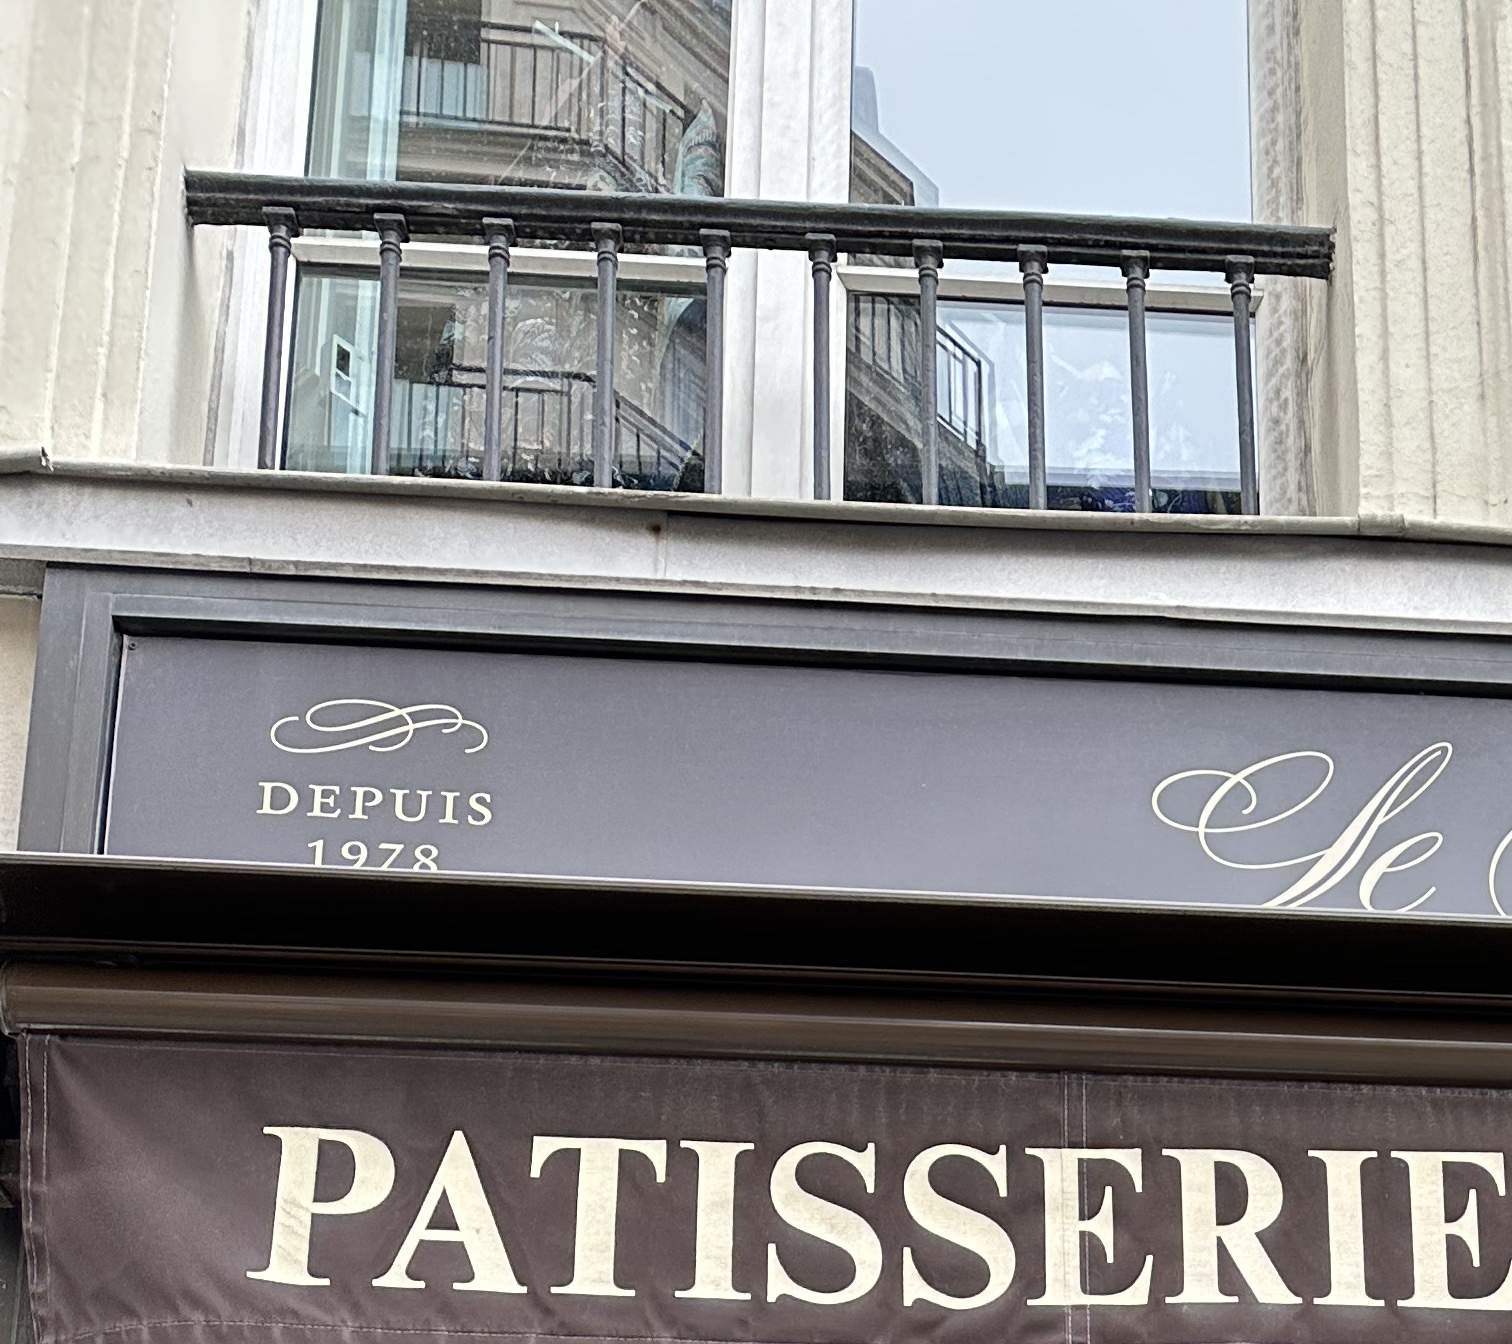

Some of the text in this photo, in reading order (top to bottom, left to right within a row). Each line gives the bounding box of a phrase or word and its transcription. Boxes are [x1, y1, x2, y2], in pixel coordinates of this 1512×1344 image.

[256, 781, 493, 826] DEPUIS
[1151, 741, 1454, 912] Le
[307, 838, 440, 873] 1978
